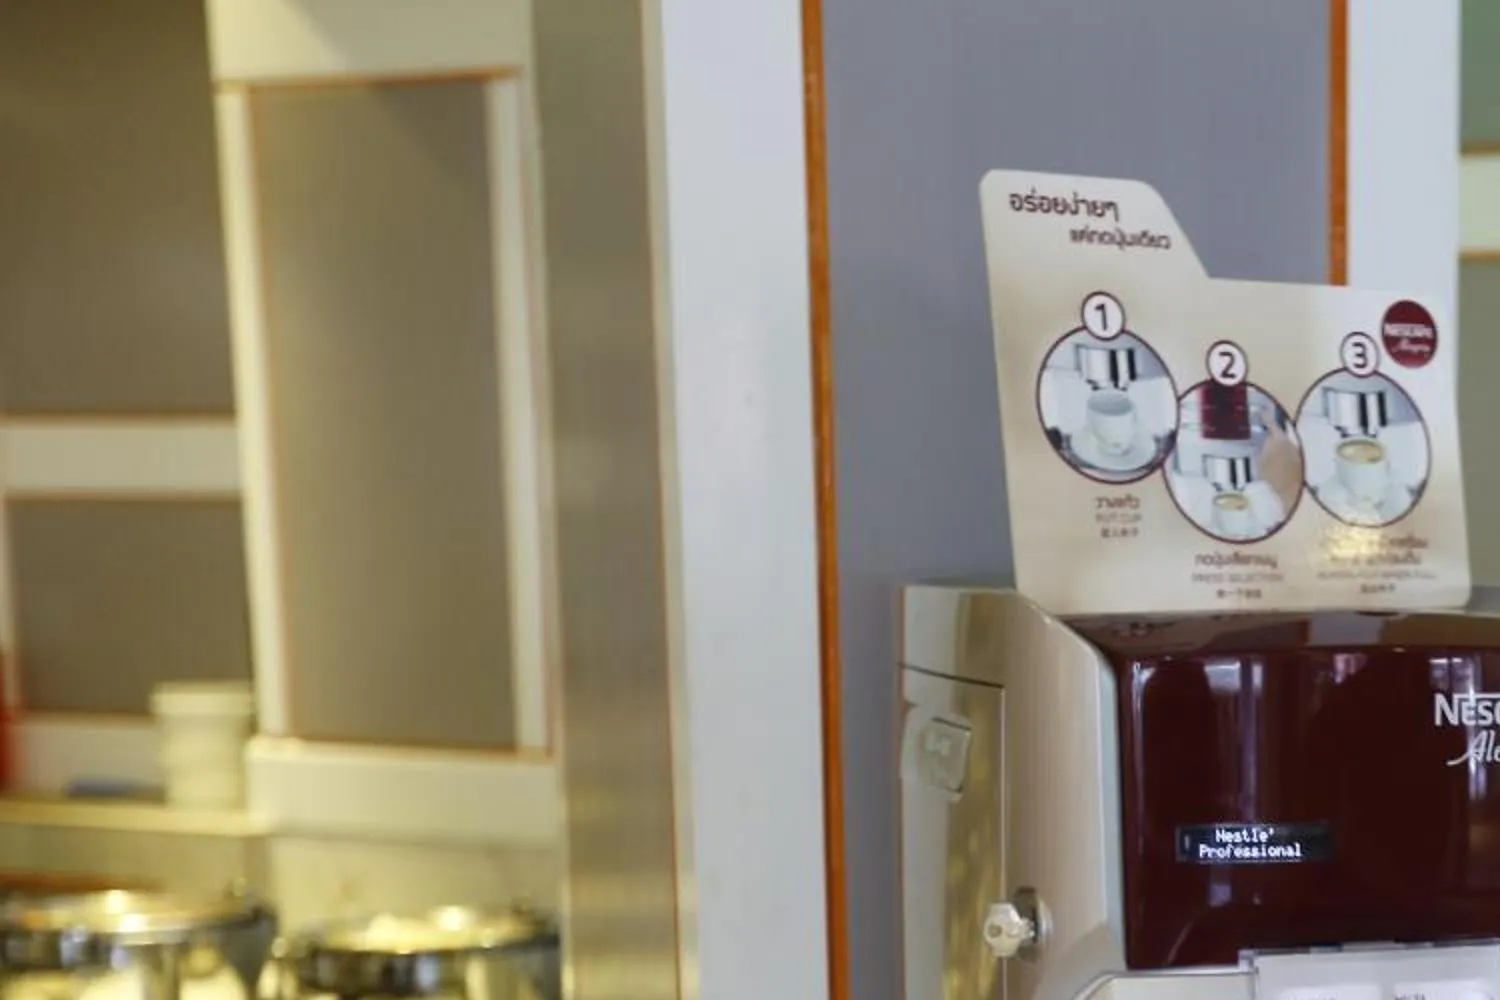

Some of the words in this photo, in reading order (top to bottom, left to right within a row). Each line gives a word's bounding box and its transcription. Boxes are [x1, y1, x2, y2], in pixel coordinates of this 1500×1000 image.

[1095, 303, 1107, 331] 1
[1219, 351, 1236, 379] 2
[1351, 342, 1368, 369] 3
[1199, 842, 1302, 858] Professional
